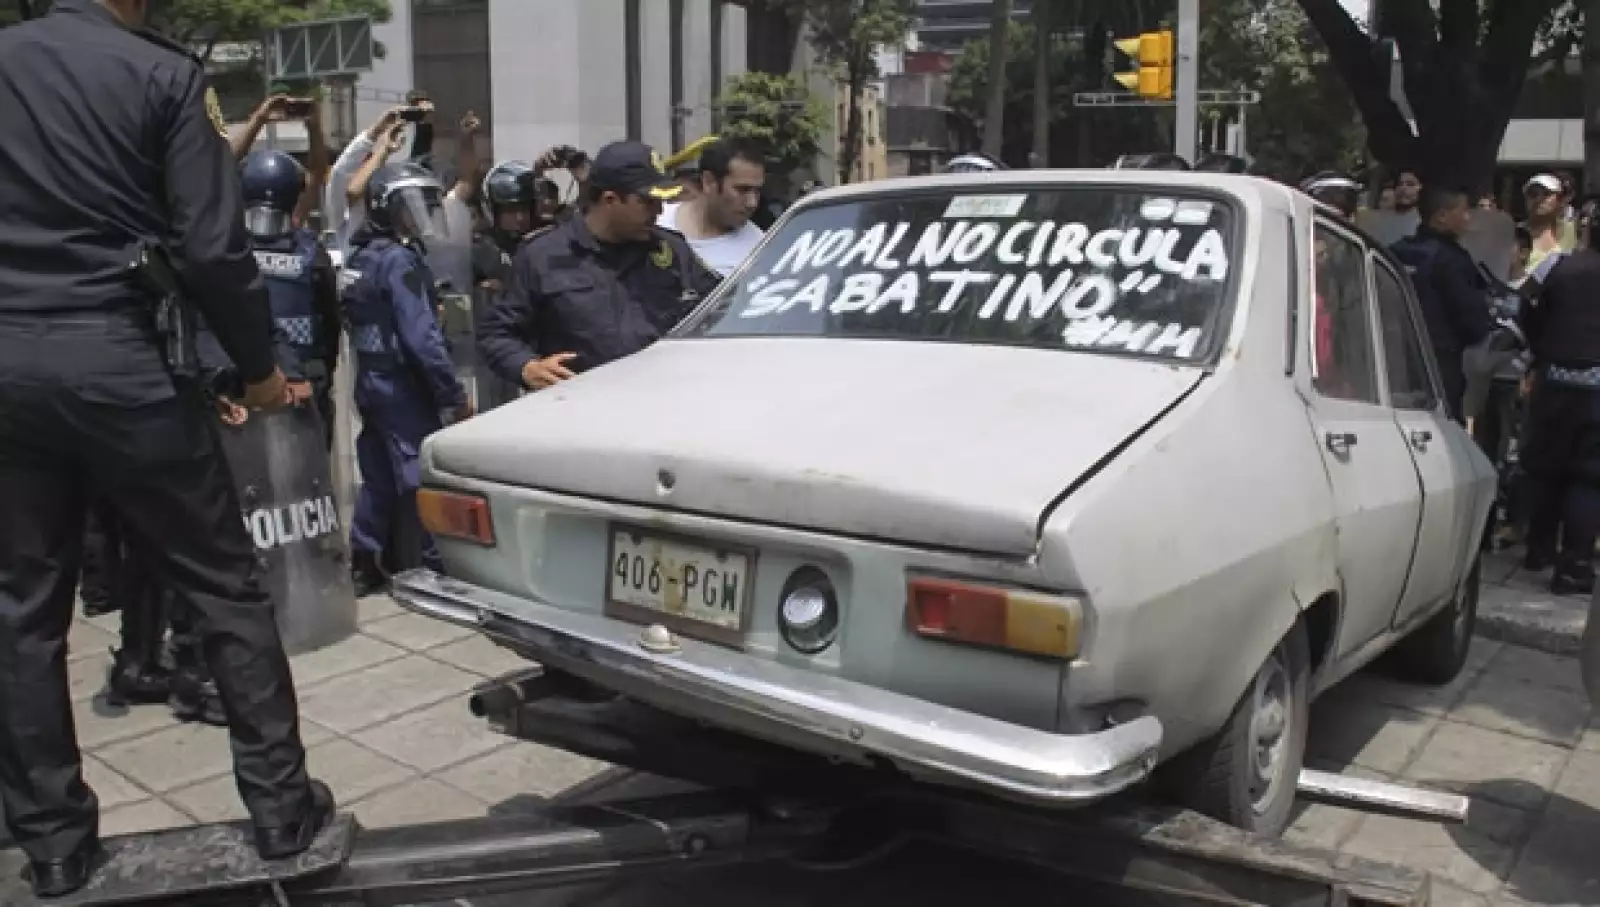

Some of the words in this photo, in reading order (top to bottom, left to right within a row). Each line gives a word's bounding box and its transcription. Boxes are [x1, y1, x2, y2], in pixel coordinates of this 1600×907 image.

[770, 228, 855, 275] NO
[837, 221, 910, 269] AL
[907, 220, 998, 267] NO
[997, 219, 1229, 281] CIRCULA
[614, 552, 738, 613] 406-PGW
